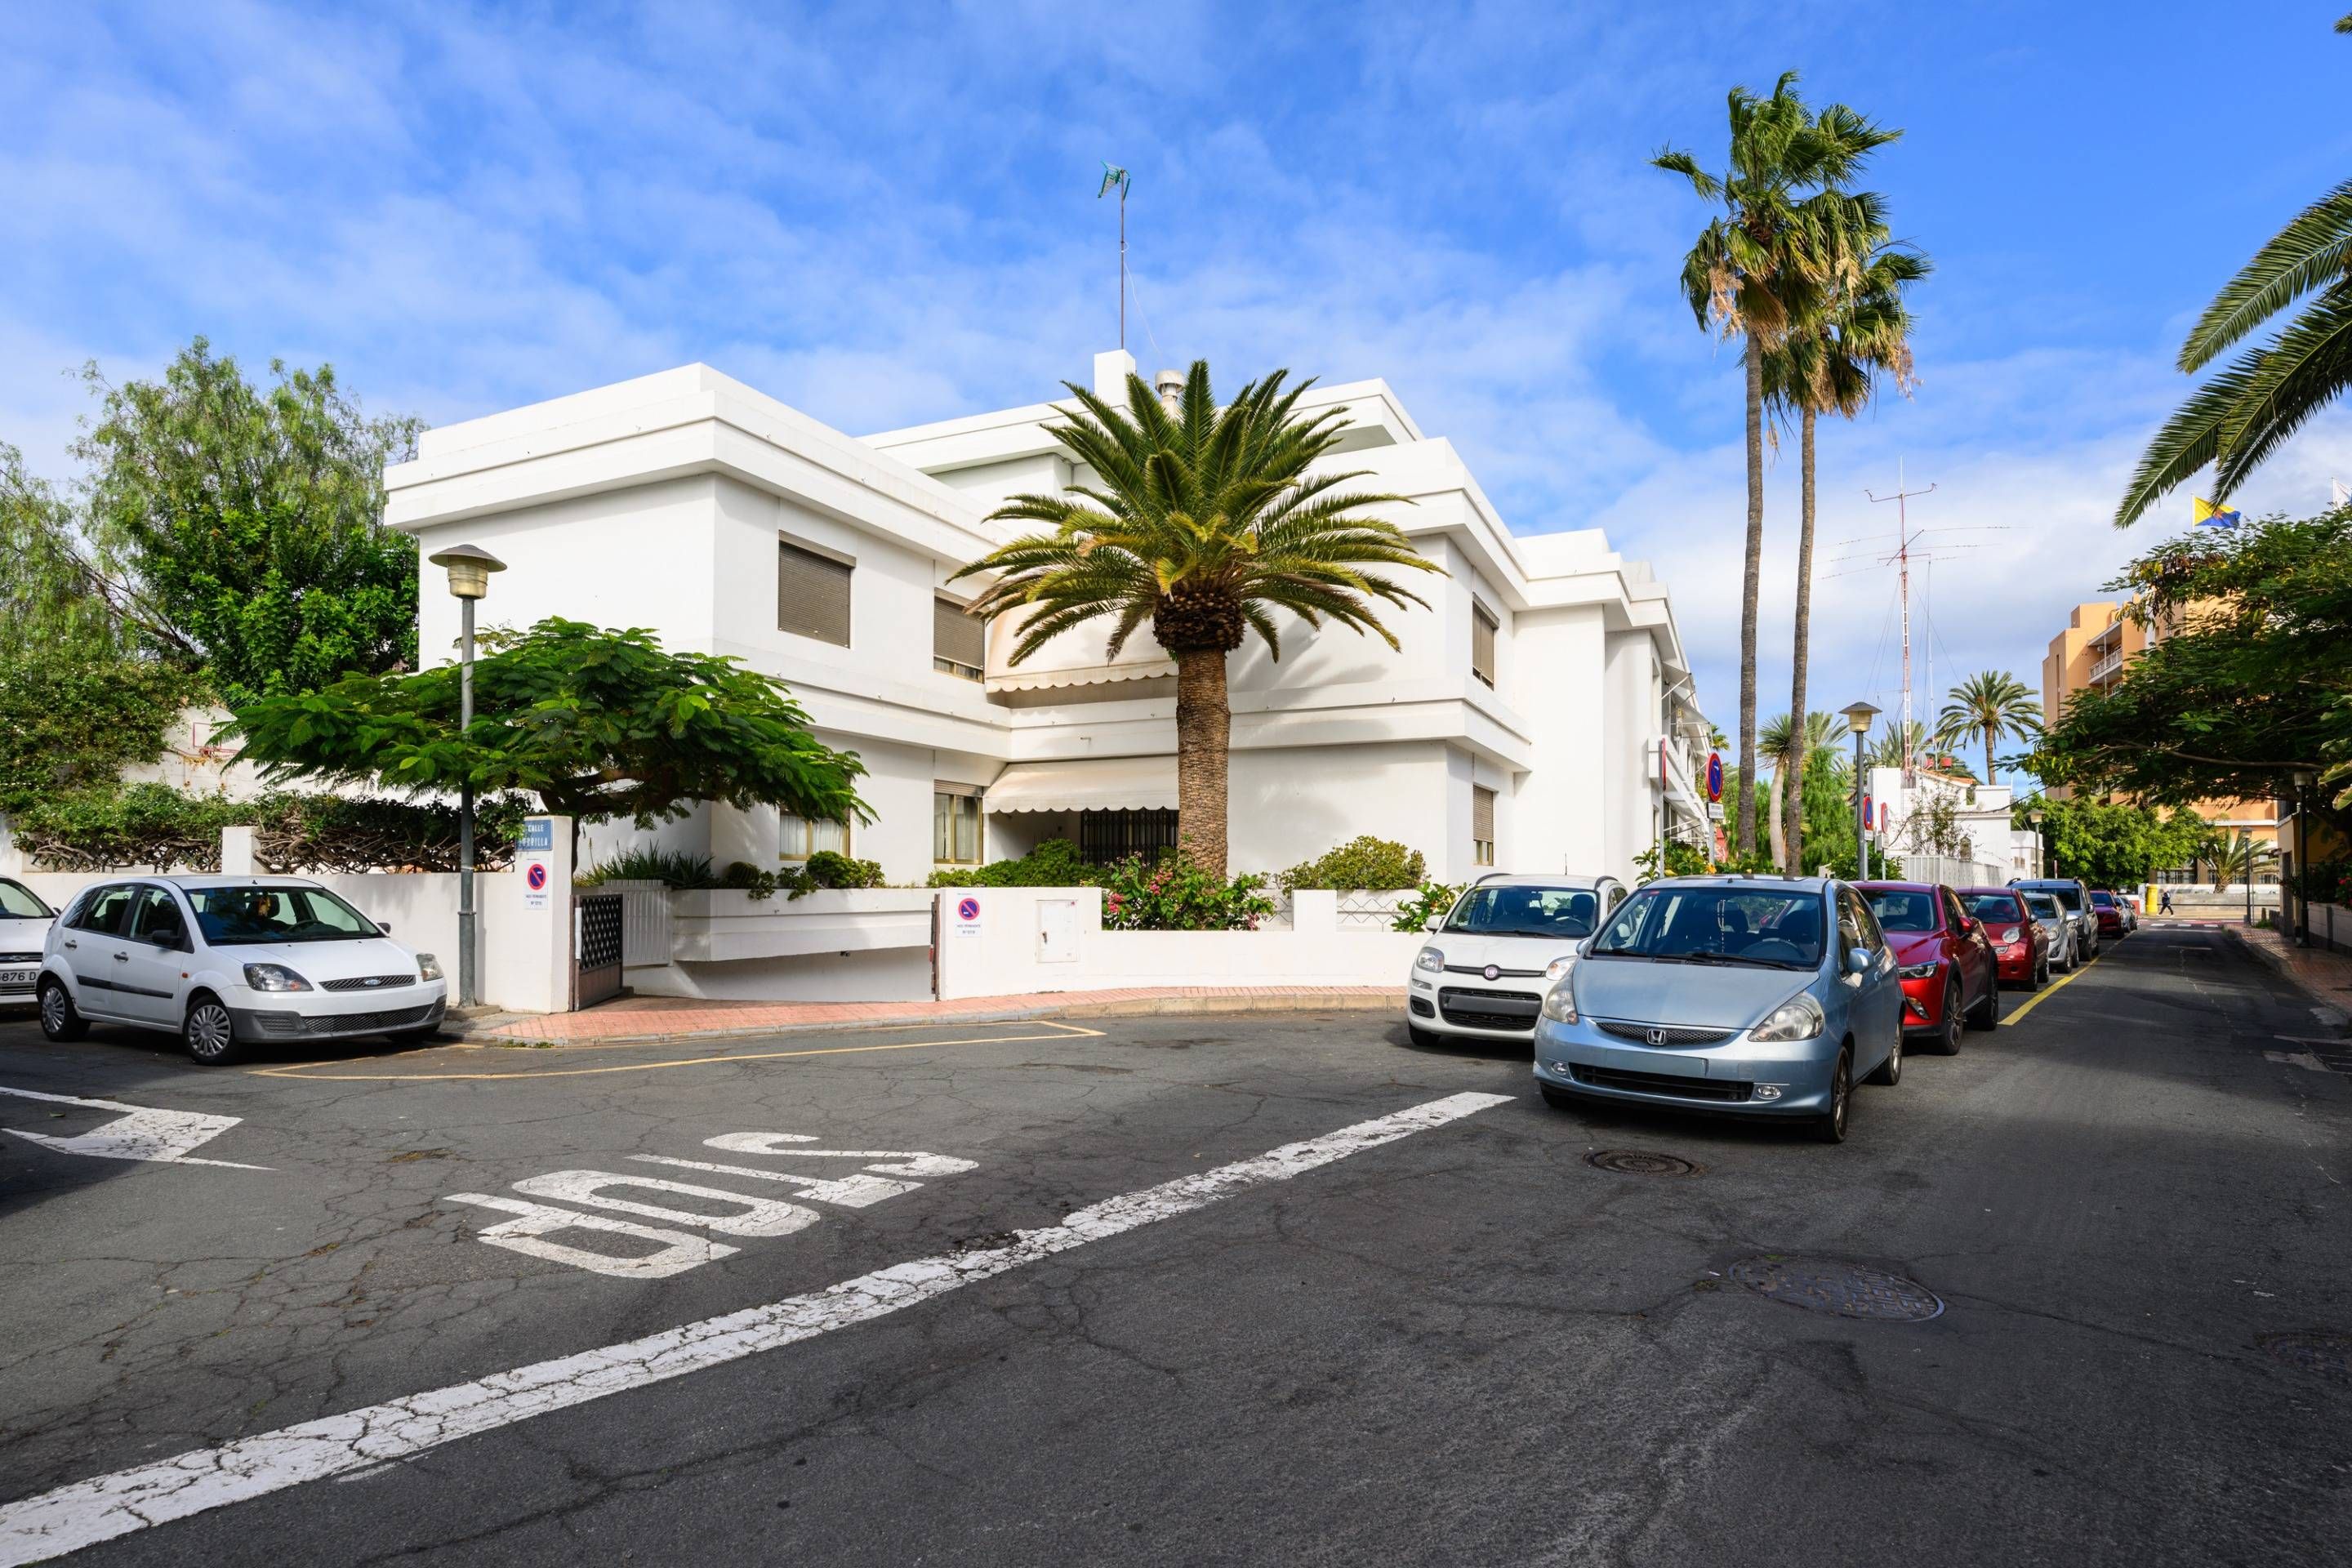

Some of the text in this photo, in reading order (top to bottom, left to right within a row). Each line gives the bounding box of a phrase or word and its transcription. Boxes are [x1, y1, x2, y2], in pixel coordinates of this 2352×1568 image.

[528, 824, 545, 832] CALLE
[0, 971, 38, 982] 876 D
[443, 1131, 980, 1279] STOP
